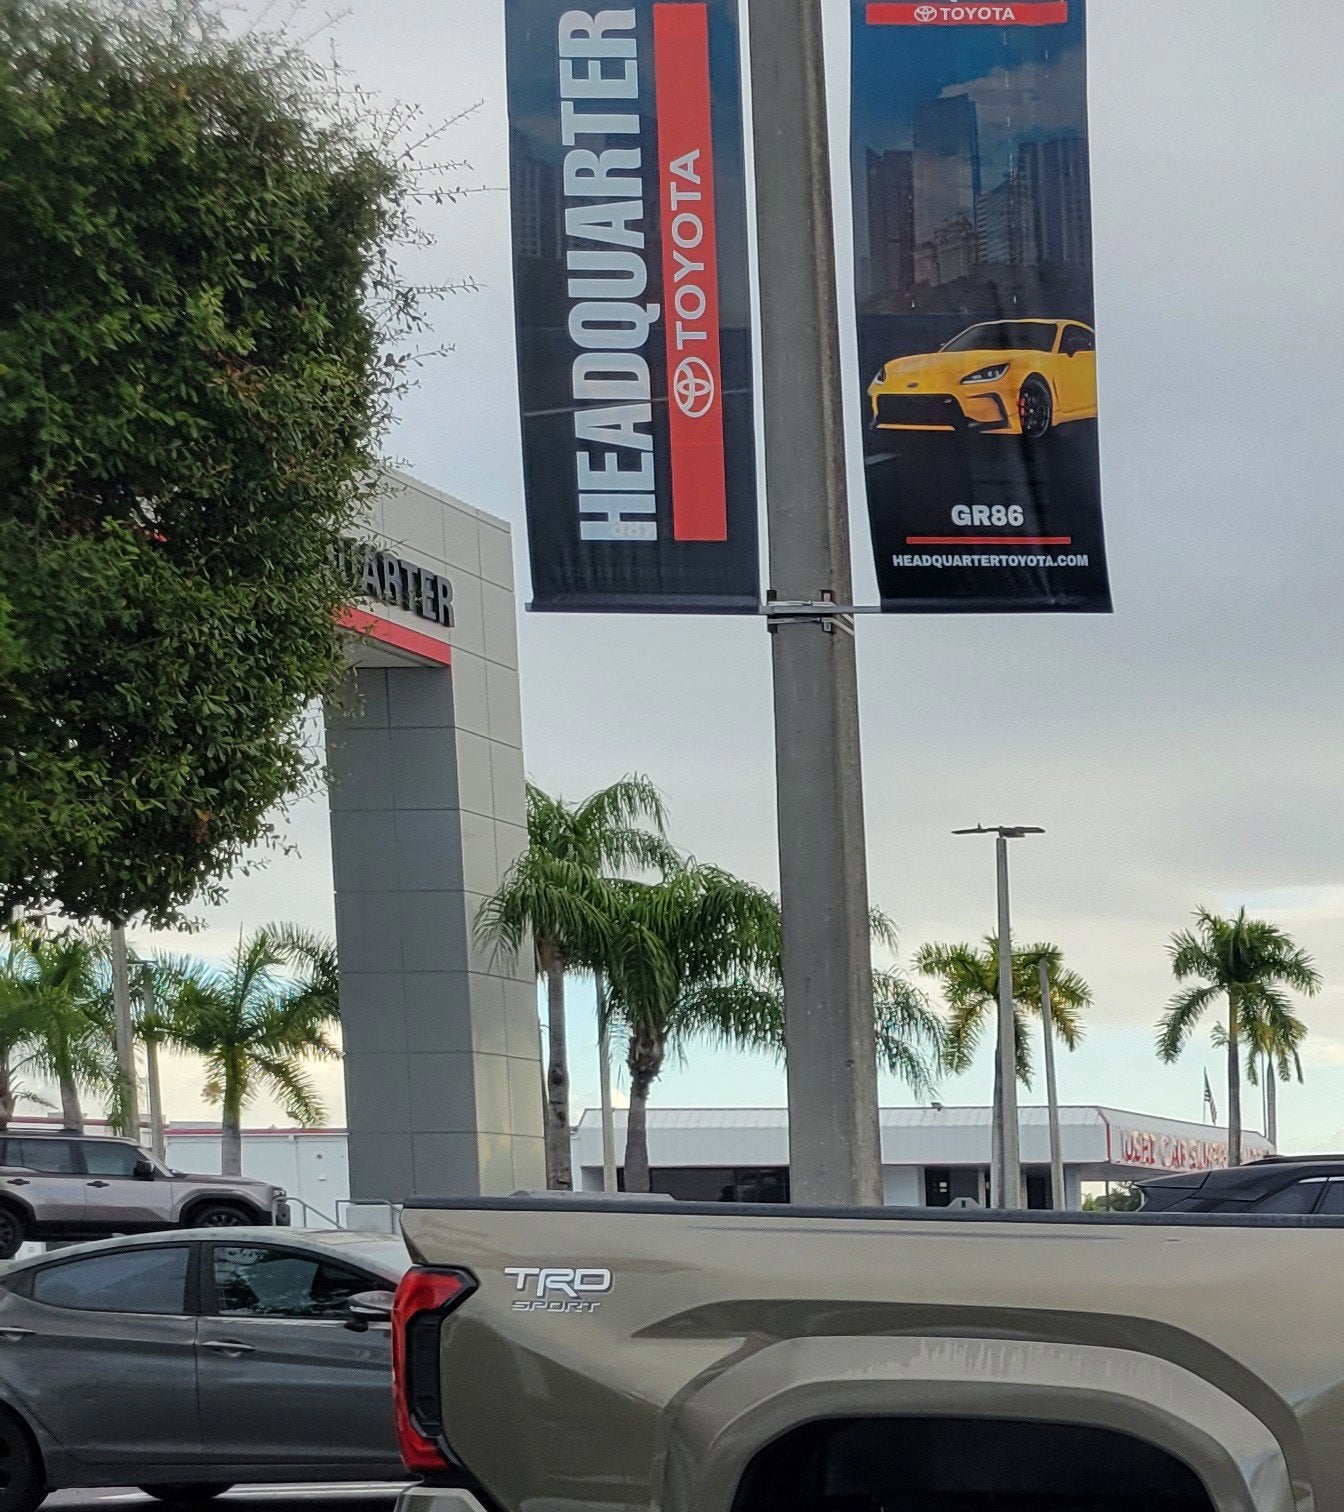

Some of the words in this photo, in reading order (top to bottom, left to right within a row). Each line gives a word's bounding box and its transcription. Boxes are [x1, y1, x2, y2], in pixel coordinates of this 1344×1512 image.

[940, 7, 1016, 21] TOYOTA
[670, 149, 708, 351] TOYOTA
[558, 8, 660, 541] HEADQUARTER
[951, 504, 1025, 526] GR86
[892, 554, 1089, 568] HEADQUARTERTOYOTA.COM
[504, 1267, 612, 1298] TRD
[512, 1301, 601, 1313] SPORT
